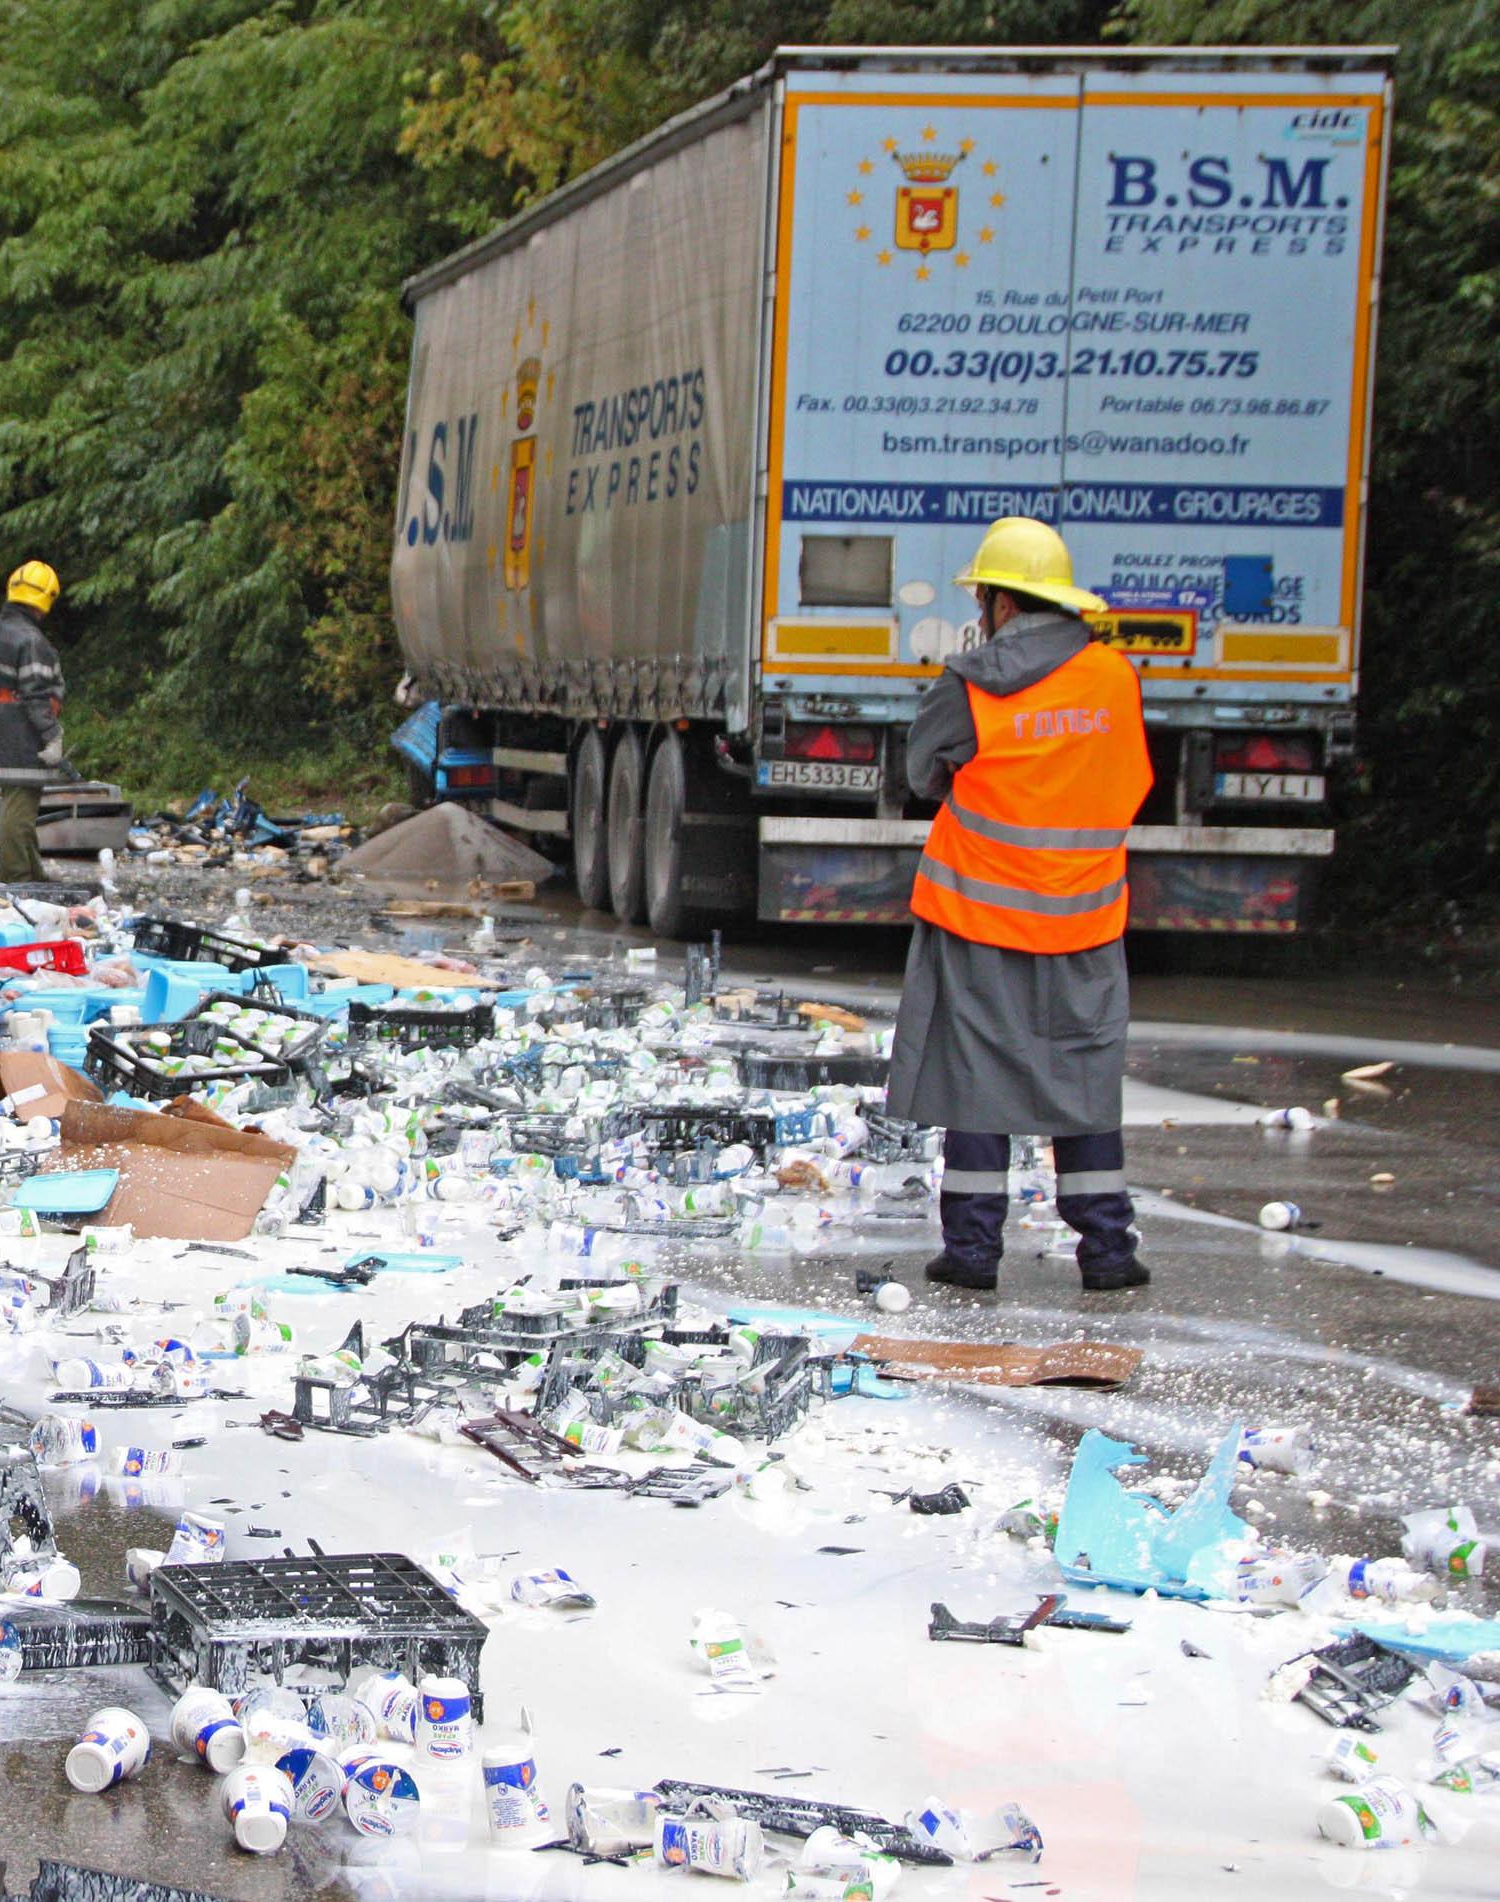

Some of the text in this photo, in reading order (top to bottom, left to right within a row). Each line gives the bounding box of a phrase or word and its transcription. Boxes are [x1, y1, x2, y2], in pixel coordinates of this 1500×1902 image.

[1106, 155, 1349, 210] B.S.M.
[1105, 213, 1348, 237] TRANSPORTS
[1004, 290, 1039, 305] Rue
[1045, 291, 1070, 306] du
[1077, 286, 1118, 303] Petit
[1124, 287, 1164, 304] Port
[897, 311, 1251, 335] 62200 BOULOGNE-SUR-MER
[571, 367, 705, 458] TRANSPORTS
[1100, 394, 1184, 414] Portable
[882, 430, 1251, 461] bsm.transports@wanadoo.fr
[565, 440, 702, 518] EXPRESS
[791, 486, 926, 518] NATIONAUX
[946, 487, 1152, 519] INTERNATIONAUX
[1175, 490, 1323, 521] GROUPAGES
